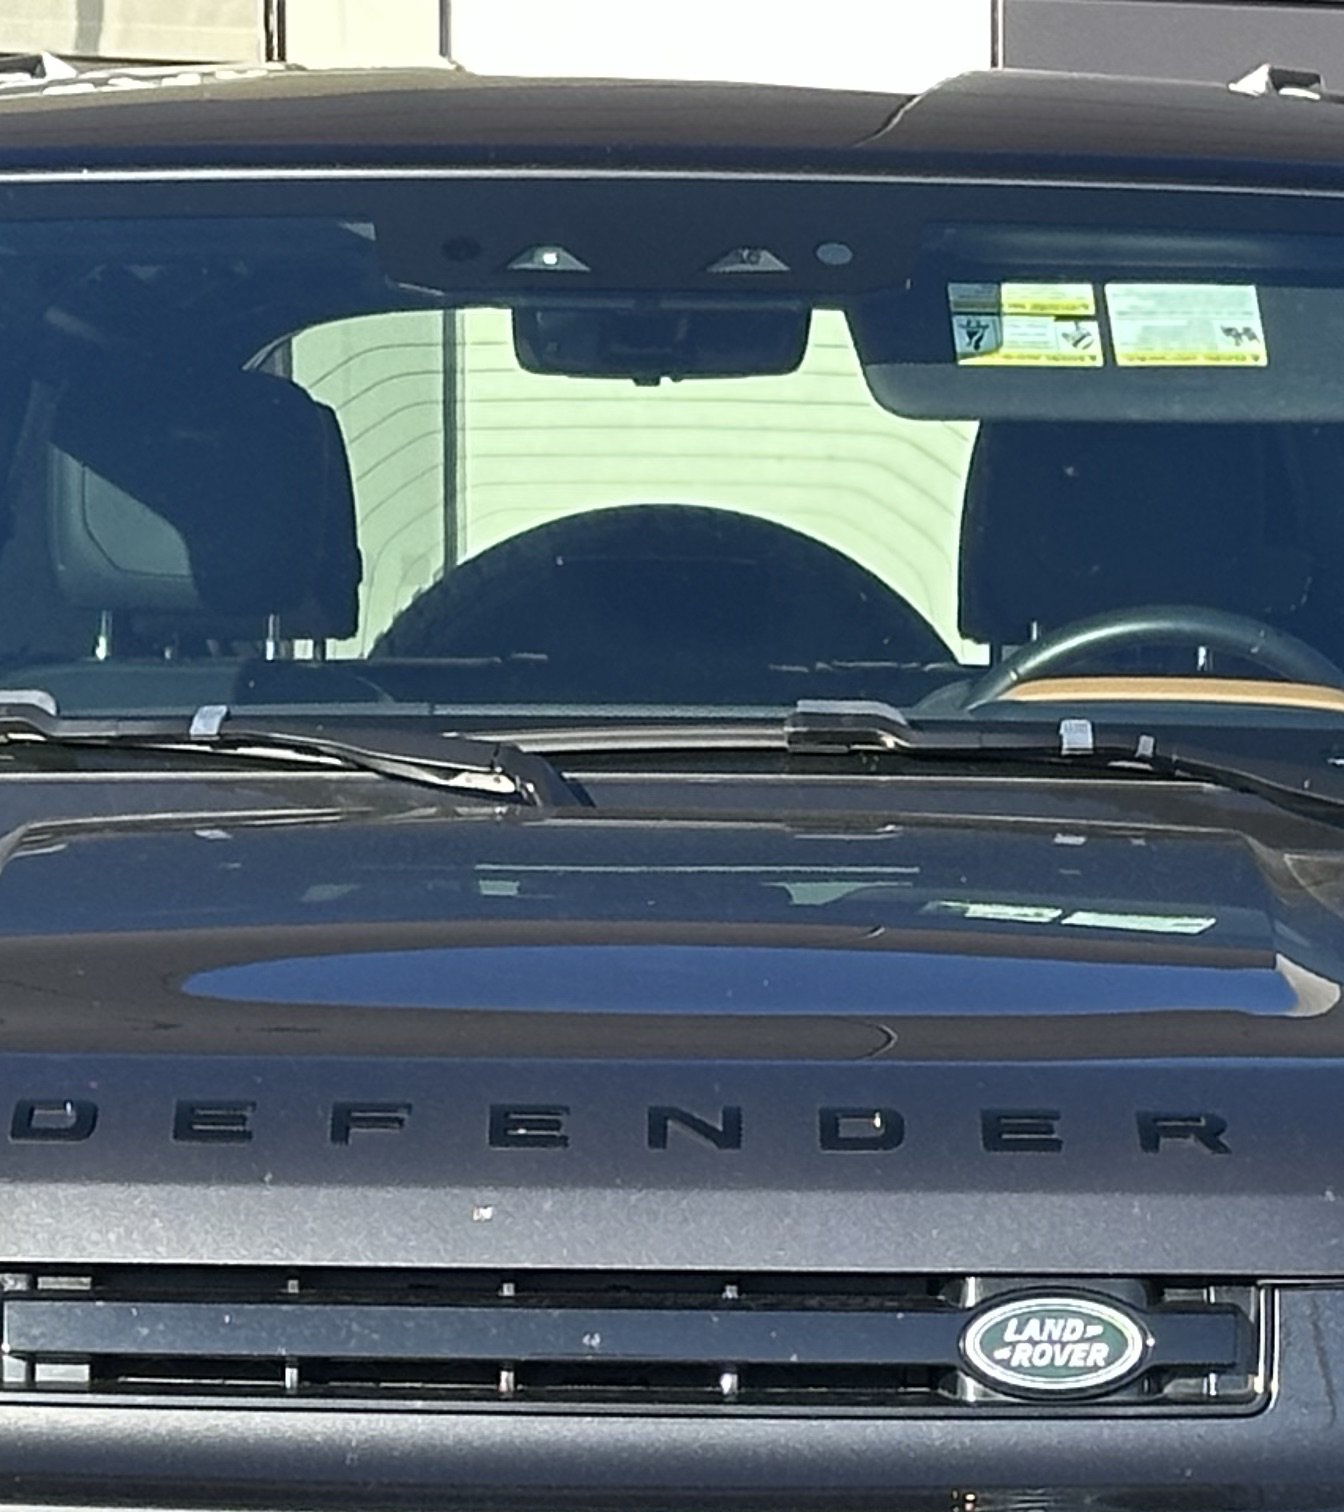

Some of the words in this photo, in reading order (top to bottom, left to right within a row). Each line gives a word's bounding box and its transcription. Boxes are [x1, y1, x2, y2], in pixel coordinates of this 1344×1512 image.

[8, 1098, 1233, 1153] DEFENDER
[1004, 1318, 1084, 1341] LAND
[1010, 1343, 1109, 1367] ROVER
